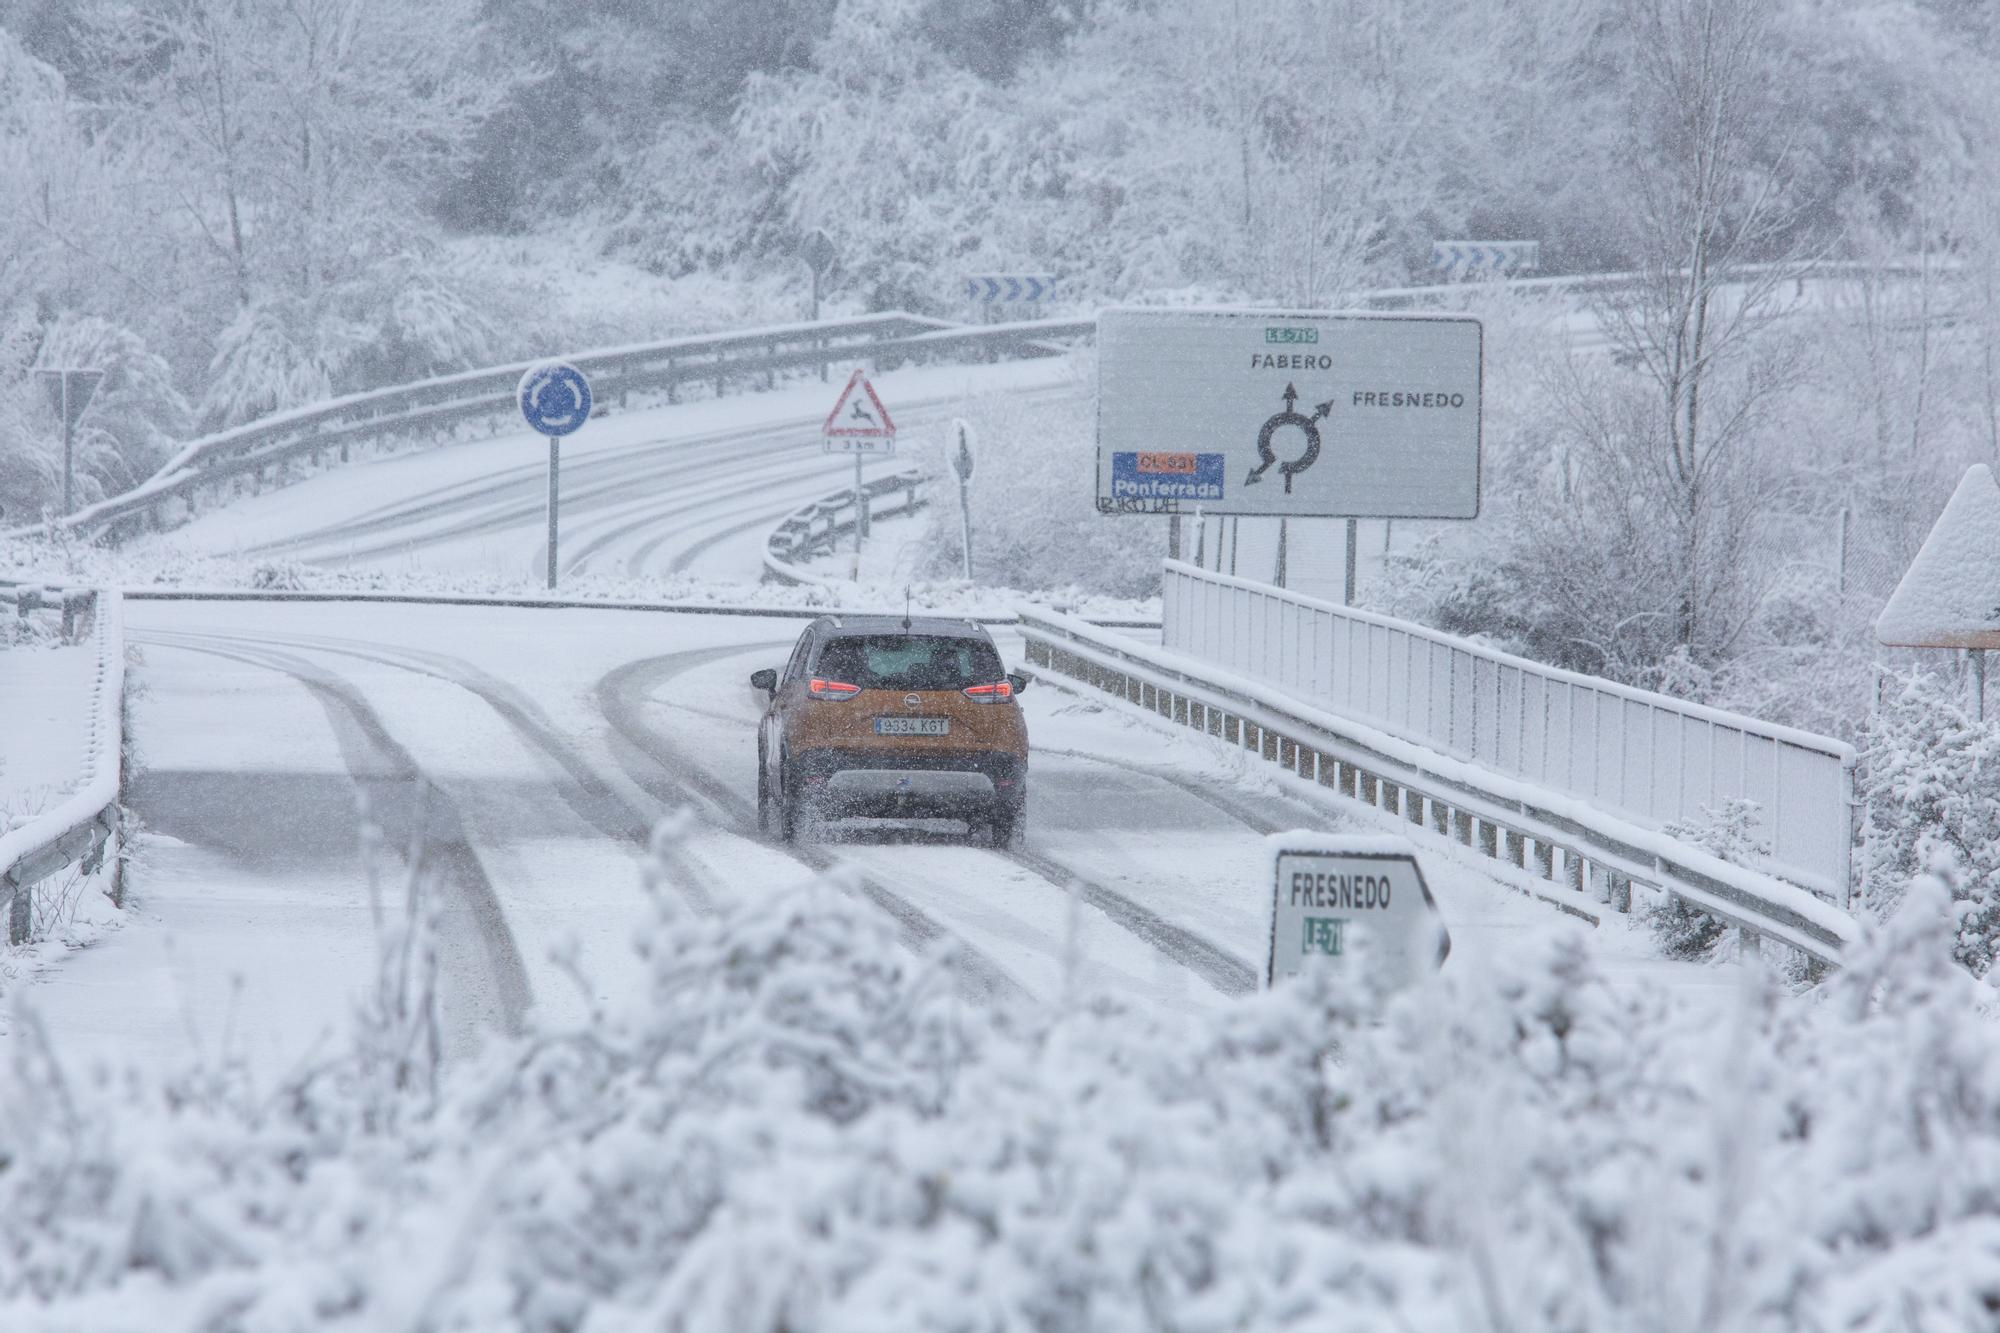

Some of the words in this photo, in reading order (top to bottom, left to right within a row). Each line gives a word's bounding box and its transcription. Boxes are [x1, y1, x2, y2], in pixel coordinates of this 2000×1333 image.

[1251, 353, 1333, 369] FABERO
[1353, 390, 1464, 408] FRESNEDO
[1114, 479, 1220, 497] Ponferrada
[884, 720, 916, 732] 9334
[921, 720, 945, 732] KGT
[1291, 873, 1391, 909] FRESNEDO
